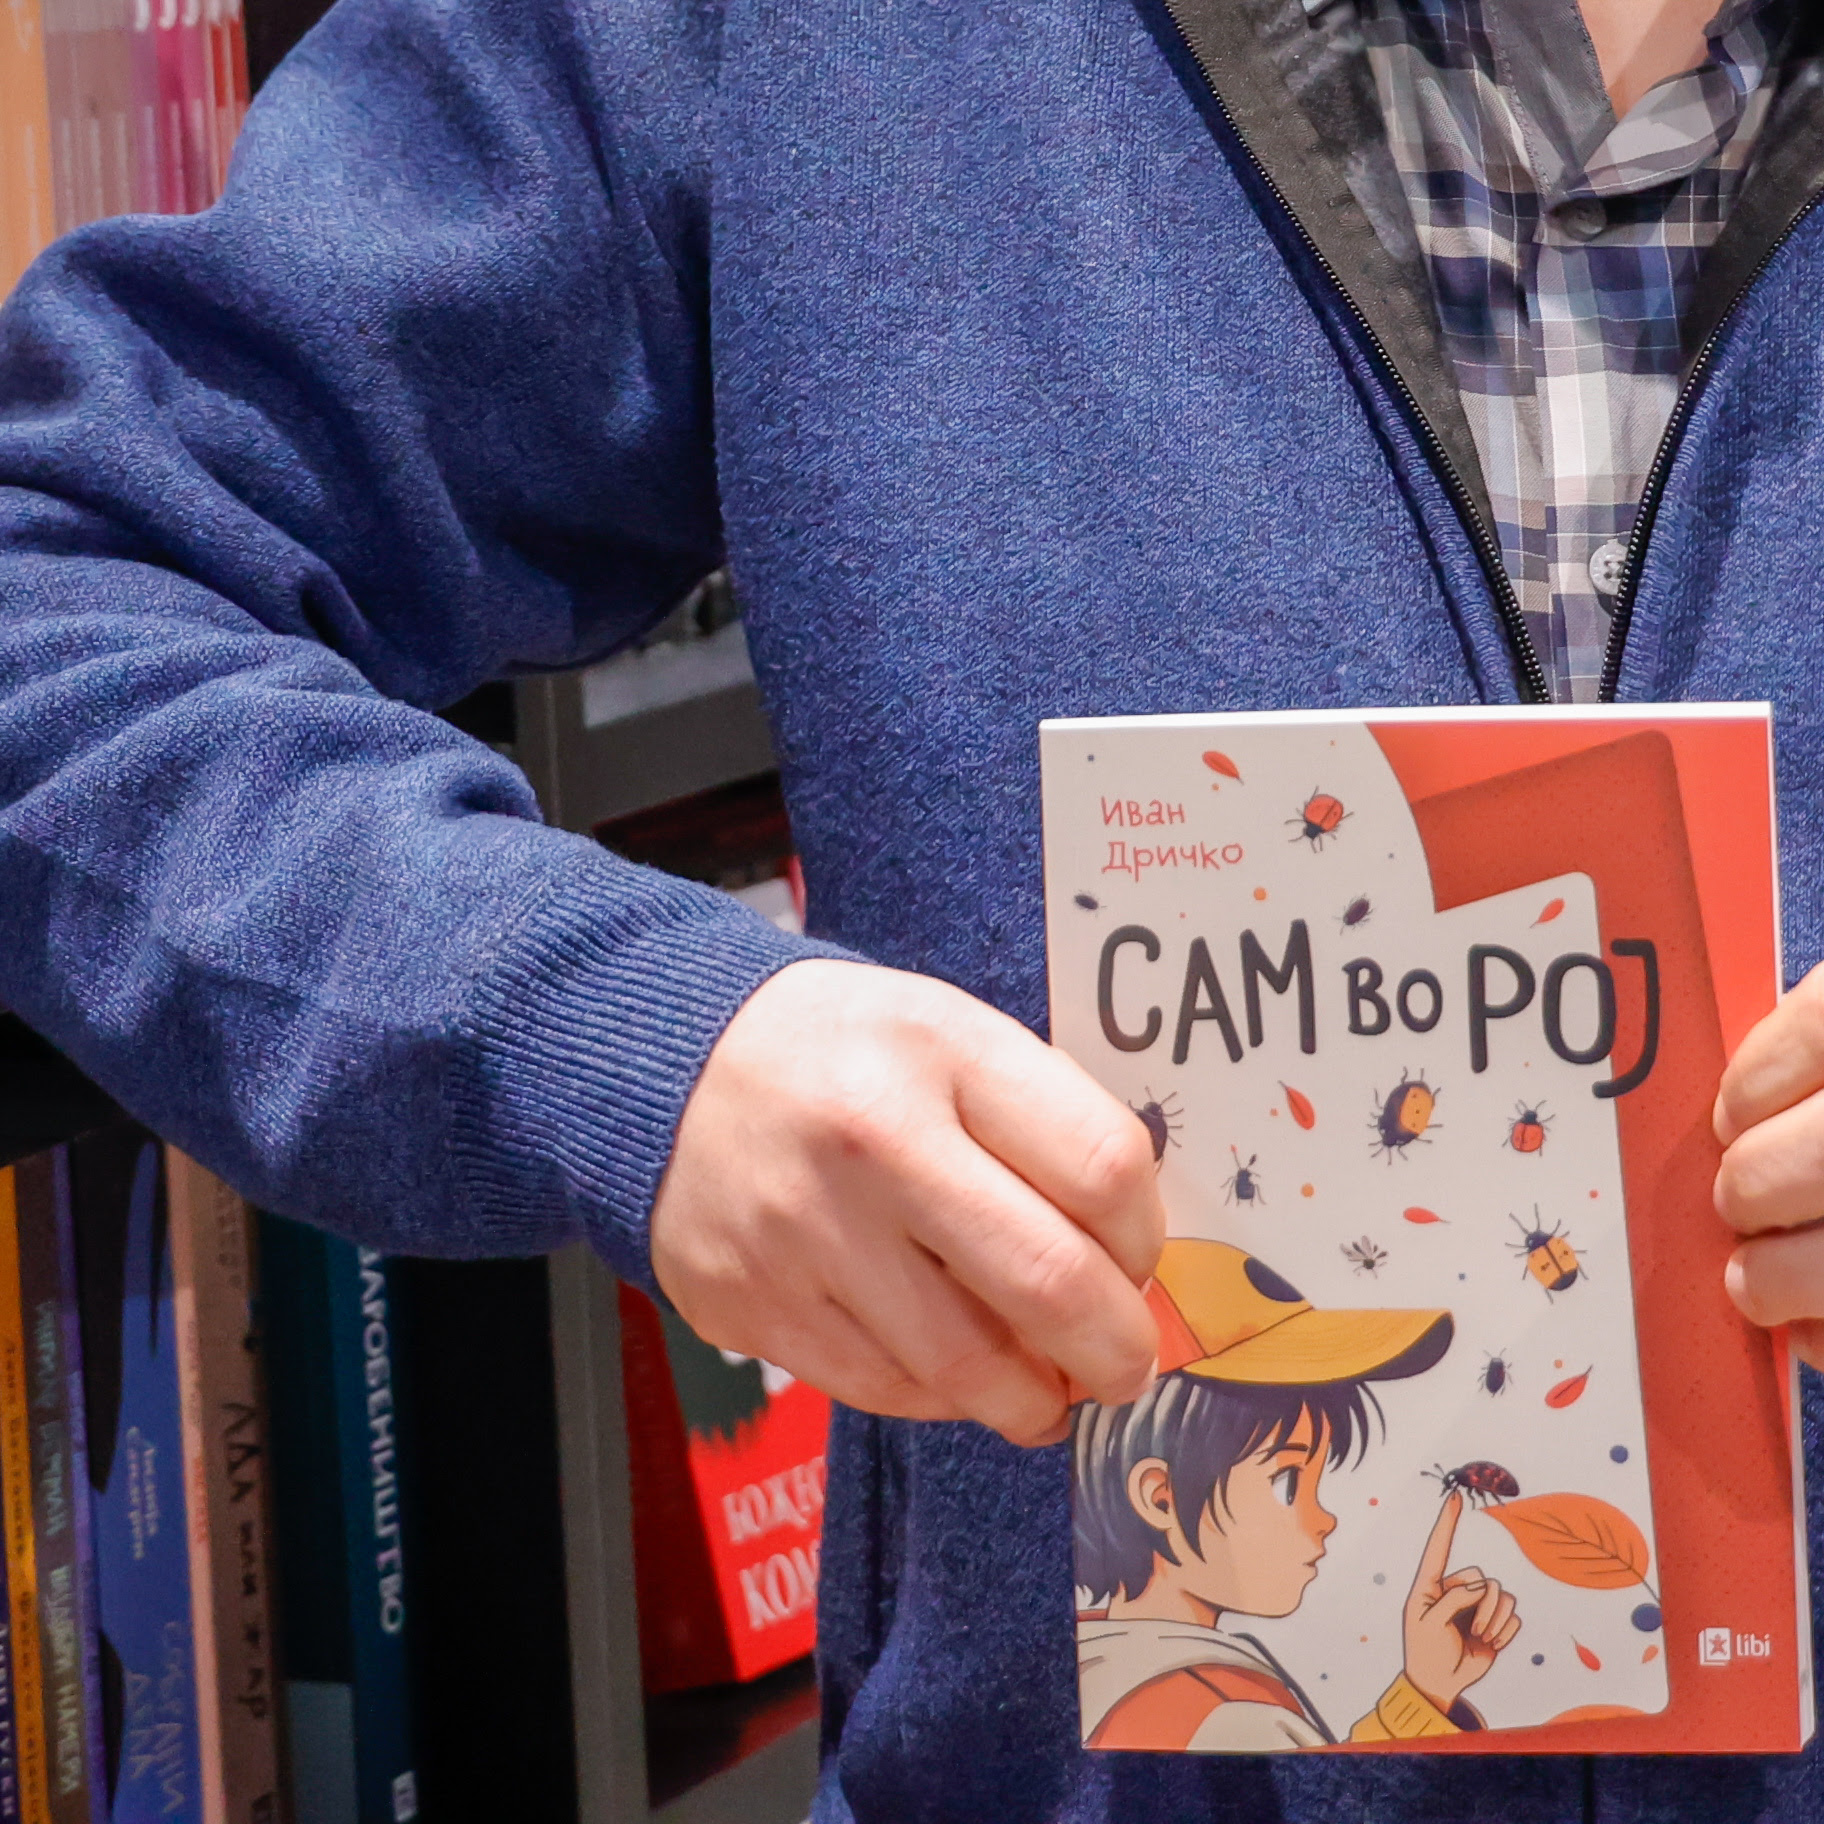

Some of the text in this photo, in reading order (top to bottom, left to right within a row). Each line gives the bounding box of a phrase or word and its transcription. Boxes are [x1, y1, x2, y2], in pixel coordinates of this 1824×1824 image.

[1101, 796, 1186, 828] Иван
[1102, 839, 1245, 882] Дричко
[1097, 918, 1317, 1065] САМ
[1468, 937, 1660, 1100] РОЈ
[1736, 1633, 1770, 1657] libi
